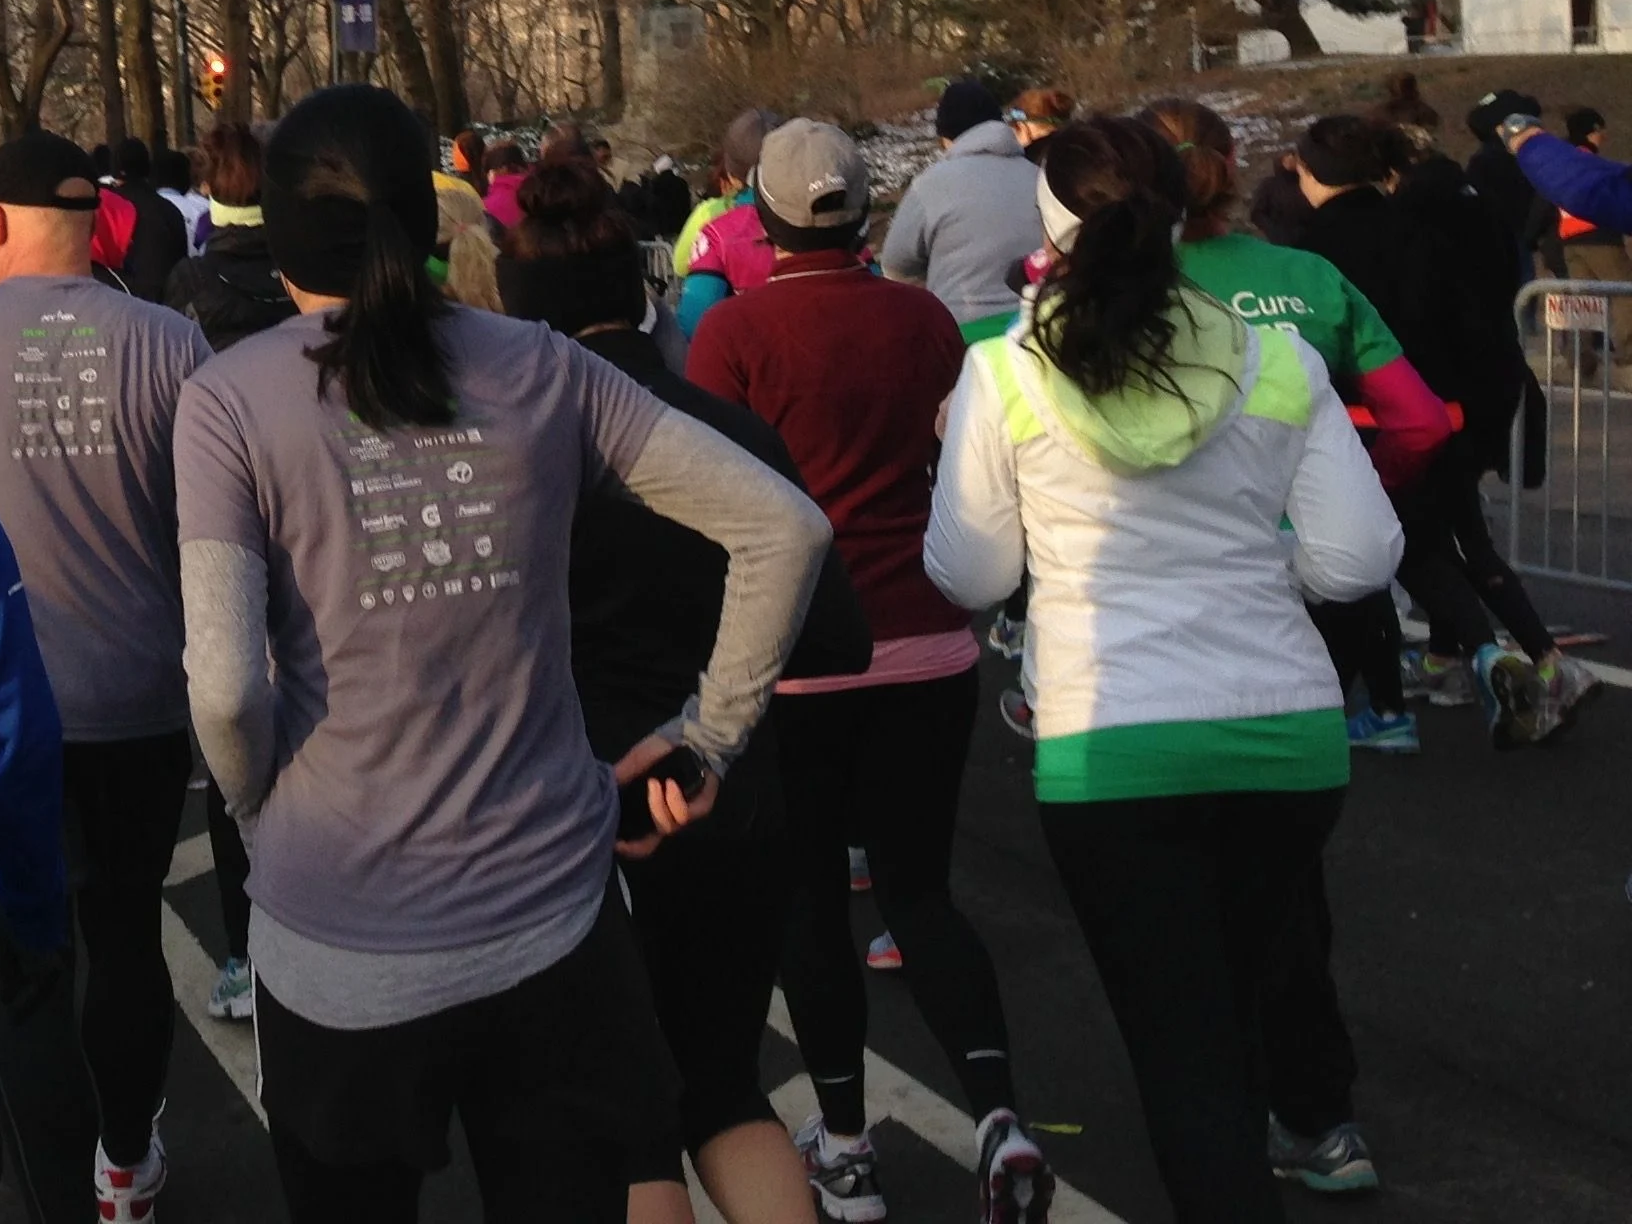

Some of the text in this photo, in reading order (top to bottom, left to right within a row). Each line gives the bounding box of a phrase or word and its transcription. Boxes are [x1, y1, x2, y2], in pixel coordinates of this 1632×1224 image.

[1230, 290, 1315, 319] Cure.
[1547, 295, 1605, 316] NATIONAL
[414, 432, 466, 449] UNITED
